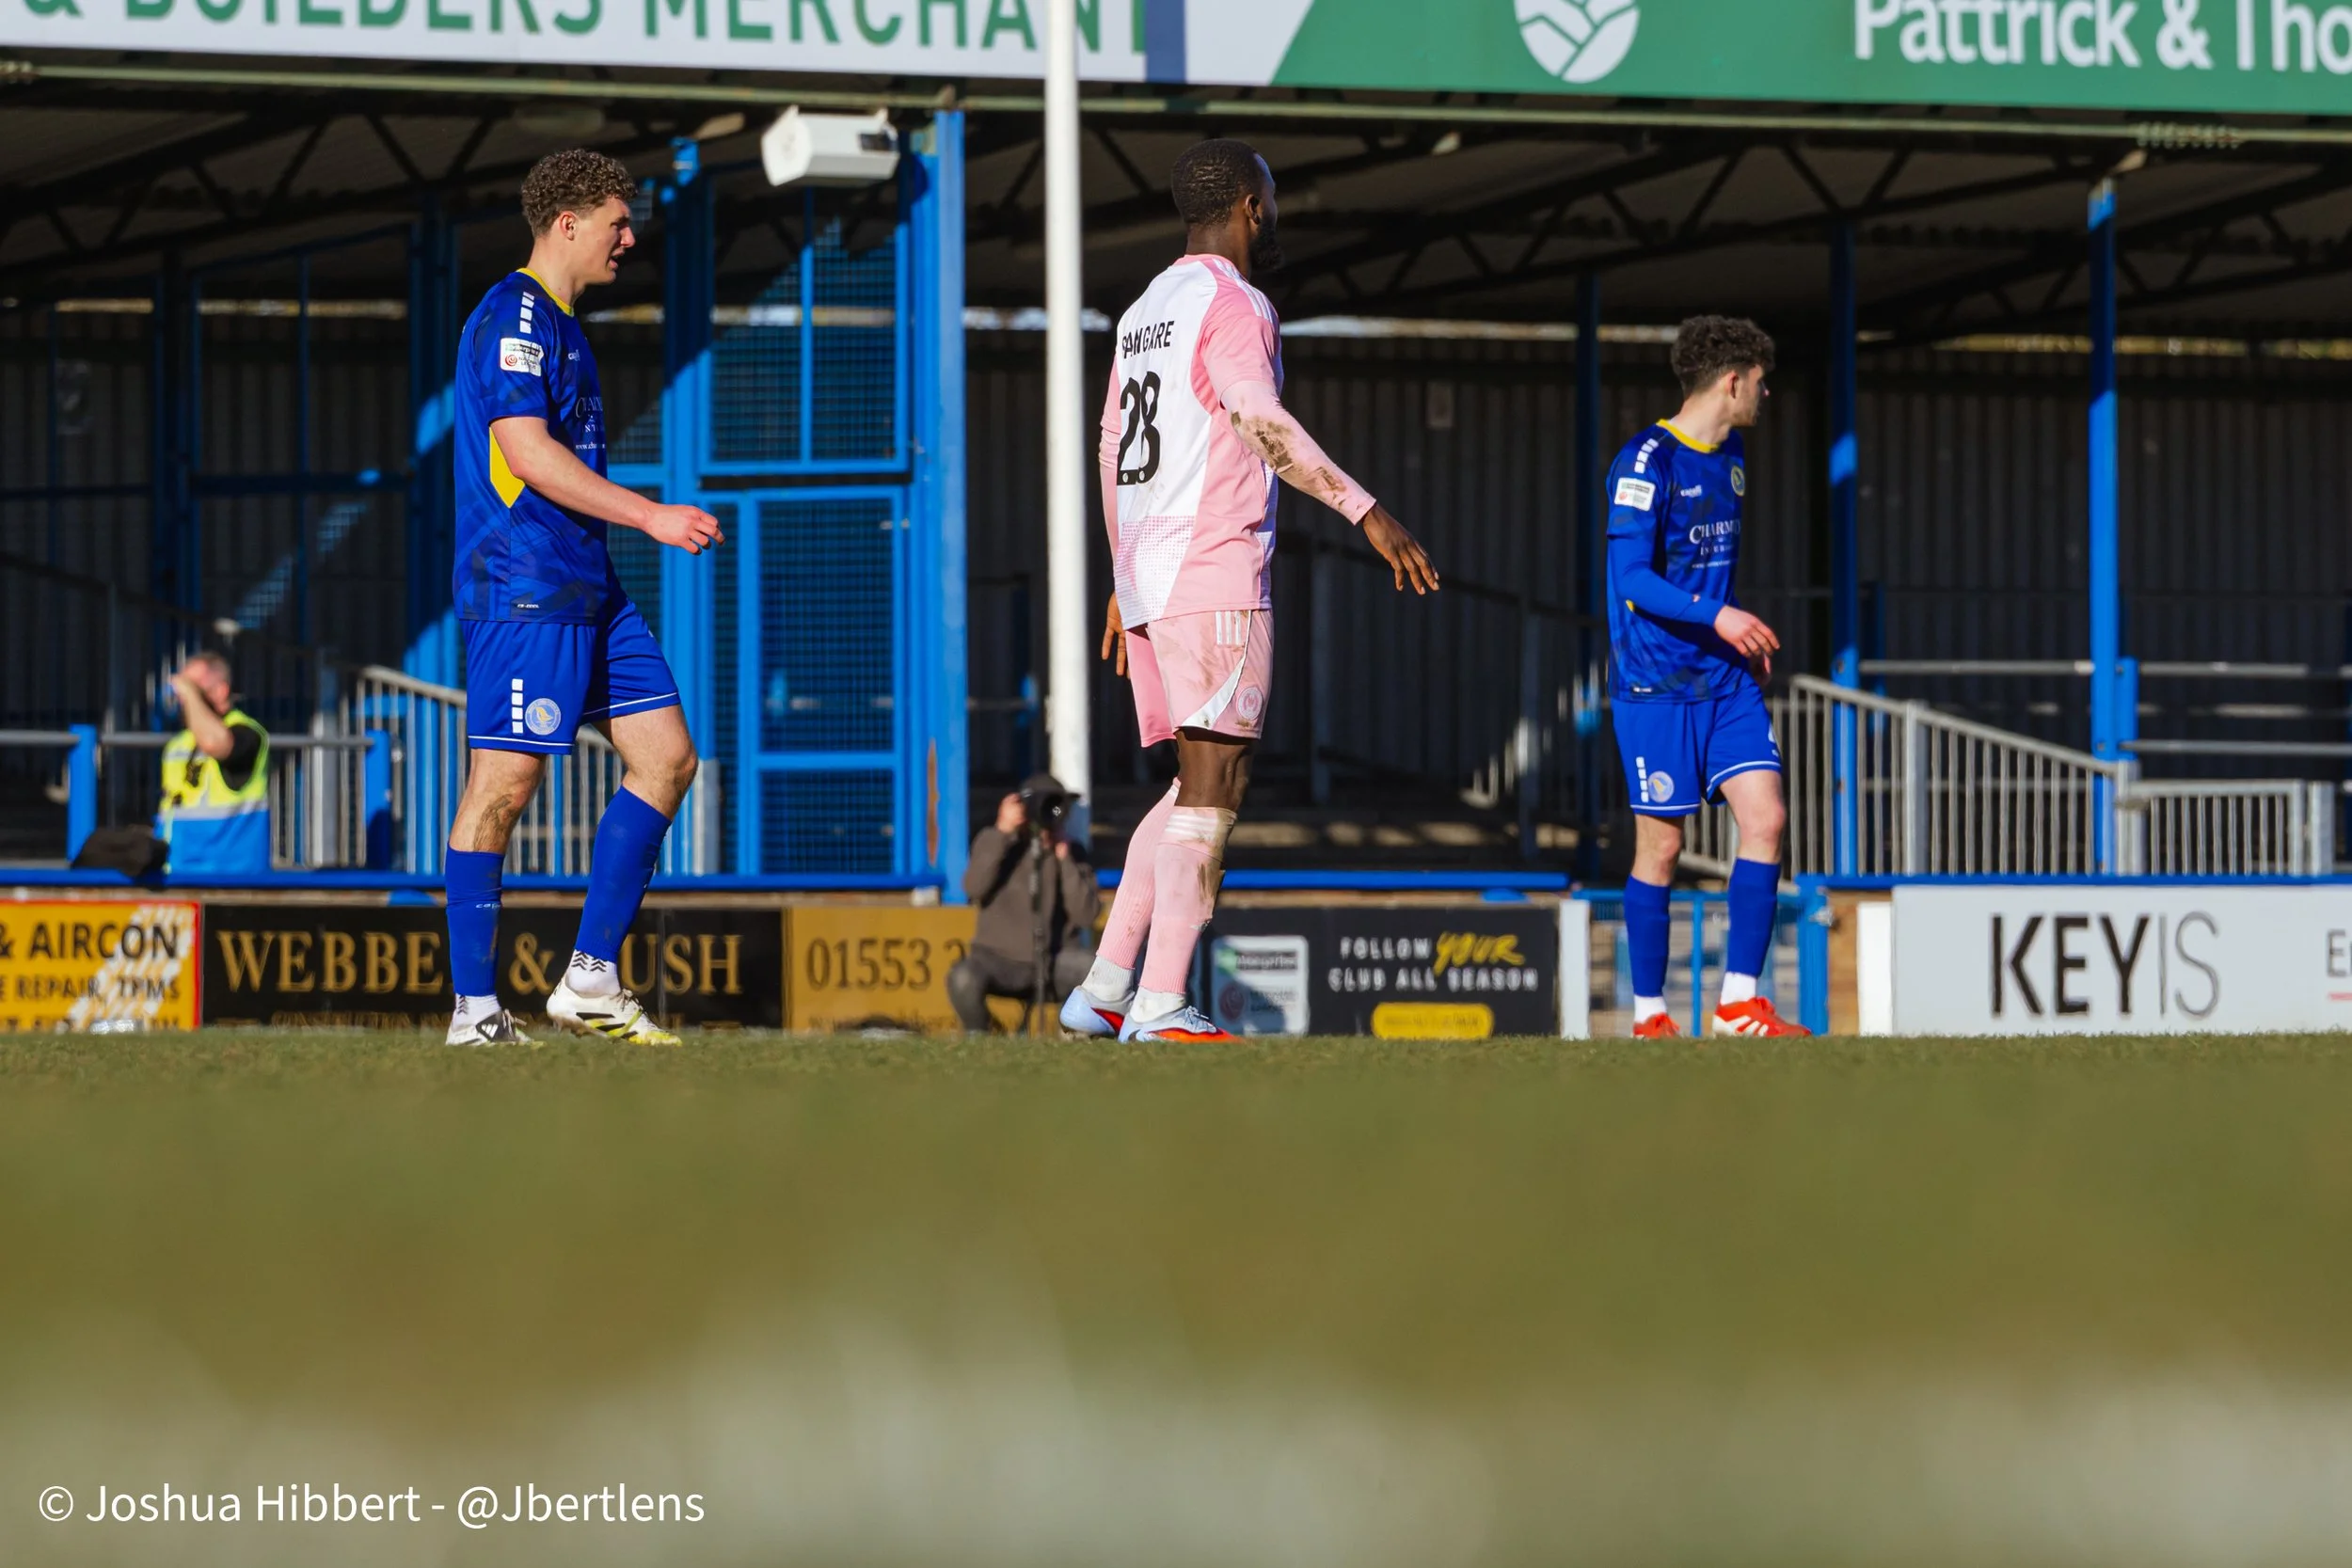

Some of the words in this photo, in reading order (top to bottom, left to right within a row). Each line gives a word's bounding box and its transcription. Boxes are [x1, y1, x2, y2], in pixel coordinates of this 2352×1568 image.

[1854, 0, 2142, 68] Pattrick
[2156, 0, 2215, 71] &
[1117, 372, 1161, 486] 28
[29, 922, 179, 959] AIRCON
[215, 929, 452, 994] WEBBE
[509, 931, 557, 996] &
[806, 937, 931, 991] 01553
[1340, 936, 1432, 960] FOLLOW
[1990, 911, 2219, 1016] KEYIS
[1327, 966, 1387, 992] CLUB
[1395, 967, 1438, 991] ALL
[1447, 966, 1538, 992] SEASON
